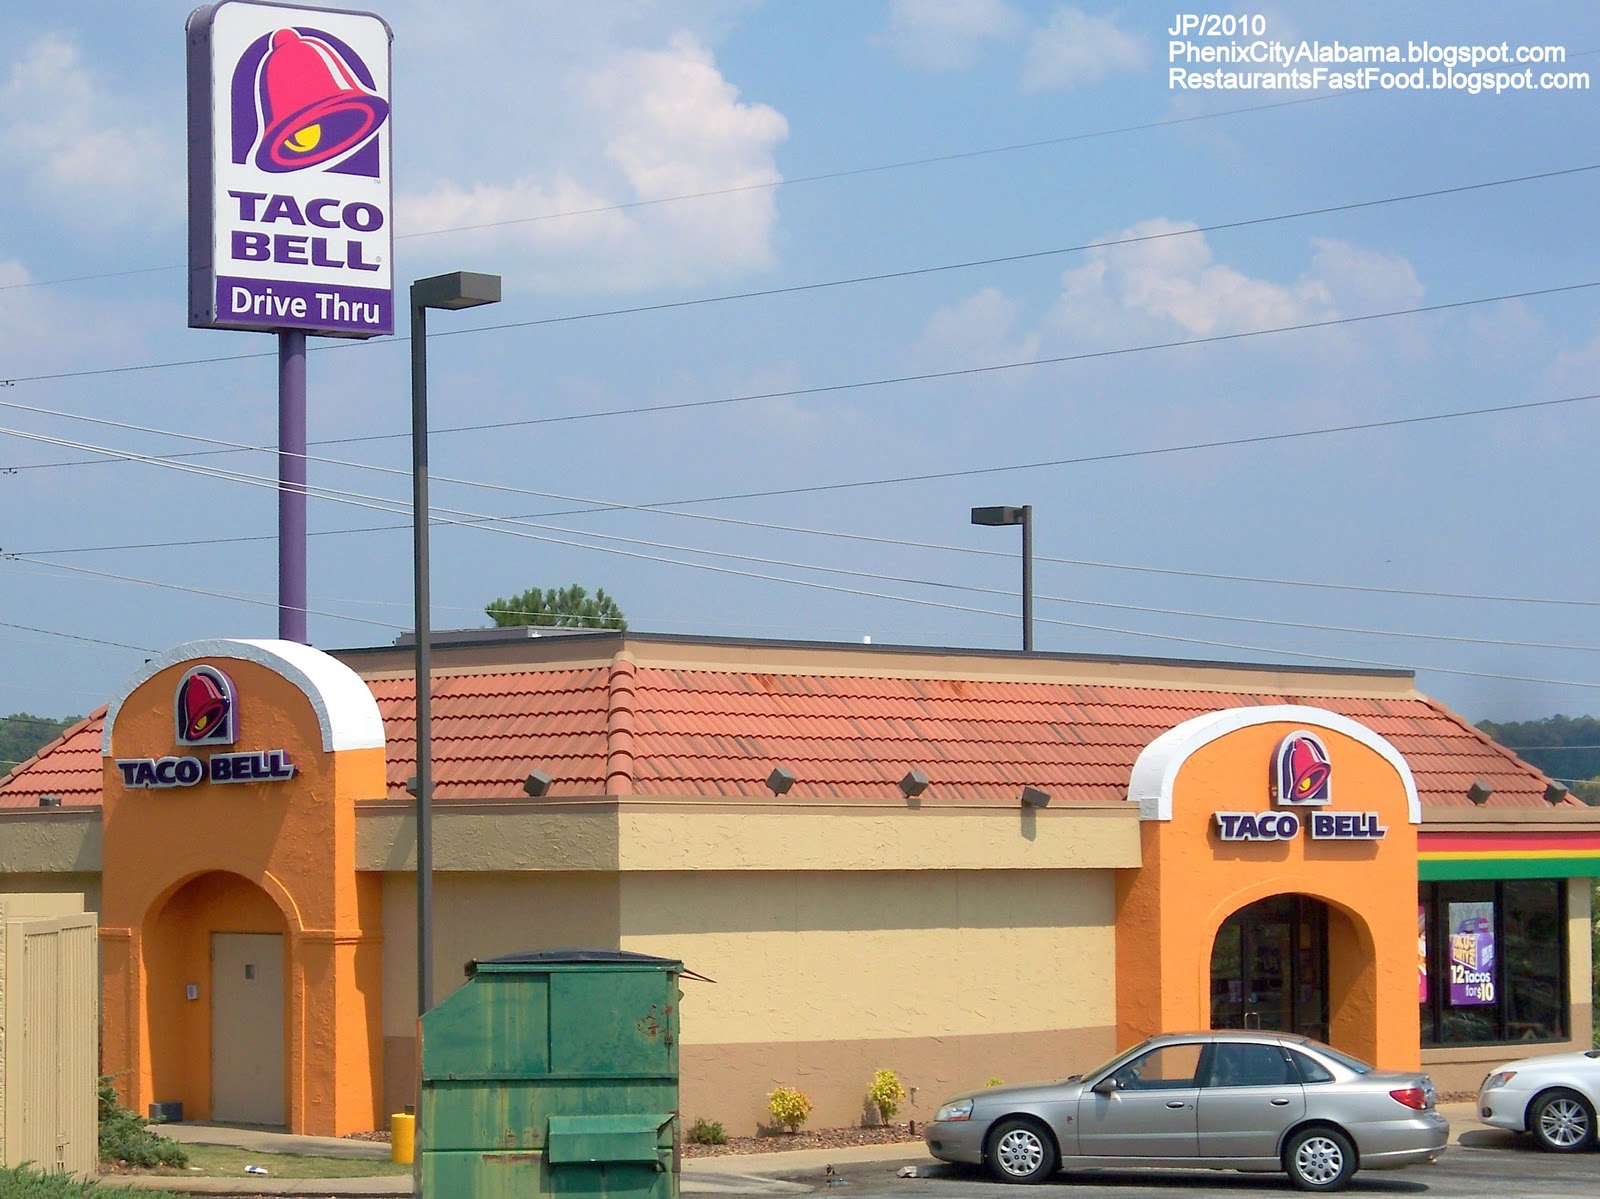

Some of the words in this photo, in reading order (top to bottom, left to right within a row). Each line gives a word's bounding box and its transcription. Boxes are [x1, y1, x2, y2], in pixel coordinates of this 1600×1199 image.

[227, 189, 384, 232] TACO
[231, 230, 382, 272] BELL
[231, 286, 307, 318] Drive
[315, 292, 380, 324] Thru
[117, 759, 200, 785] TACO
[210, 754, 290, 781] BELL
[1219, 815, 1298, 838] TACO
[1314, 815, 1386, 837] BELL
